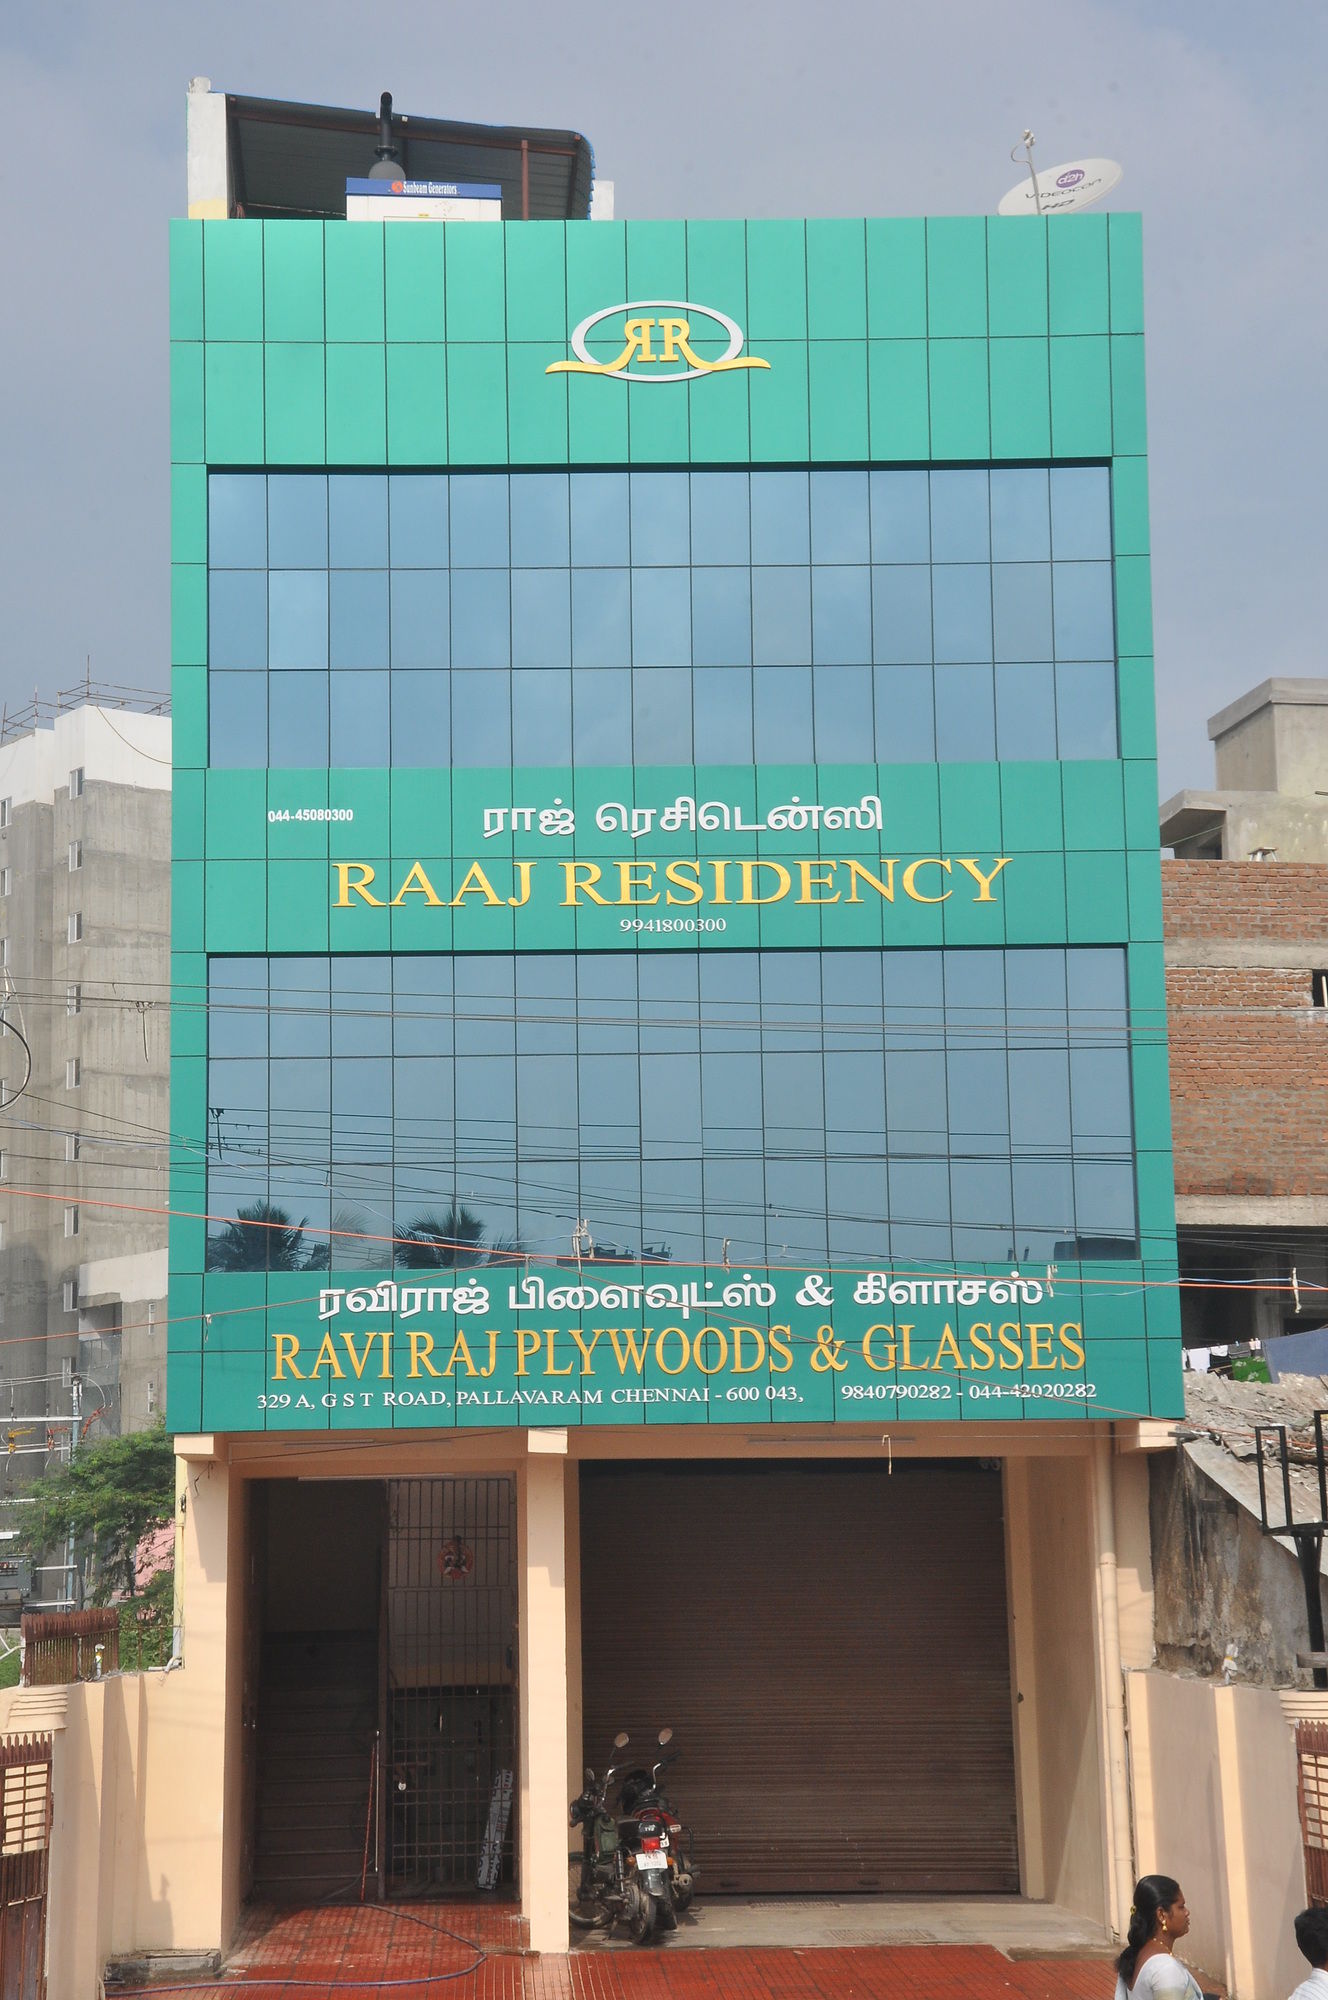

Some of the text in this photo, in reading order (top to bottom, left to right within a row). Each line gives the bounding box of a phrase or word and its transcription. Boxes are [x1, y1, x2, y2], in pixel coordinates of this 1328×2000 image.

[402, 181, 458, 195] Sunbeam Generators
[267, 808, 354, 823] 044-45080300
[483, 795, 883, 839] ராஜ் ரெசிடென்ஸி
[332, 858, 1014, 908] RAAJ RESIDENCY
[619, 918, 727, 933] 9941800300
[318, 1270, 1044, 1321] ரவிராஜ் பிளைவுட்ஸ் & கிளாசஸ்
[272, 1322, 1087, 1380] RAVI RAJ PLYWOODS & GLASSES
[257, 1394, 291, 1409] 329
[383, 1391, 453, 1408] ROAD,
[455, 1389, 603, 1406] PALLAVARAM
[610, 1387, 710, 1404] CHENNAI
[726, 1387, 760, 1402] 600
[765, 1386, 804, 1403] 043,
[841, 1385, 952, 1400] 9840790282
